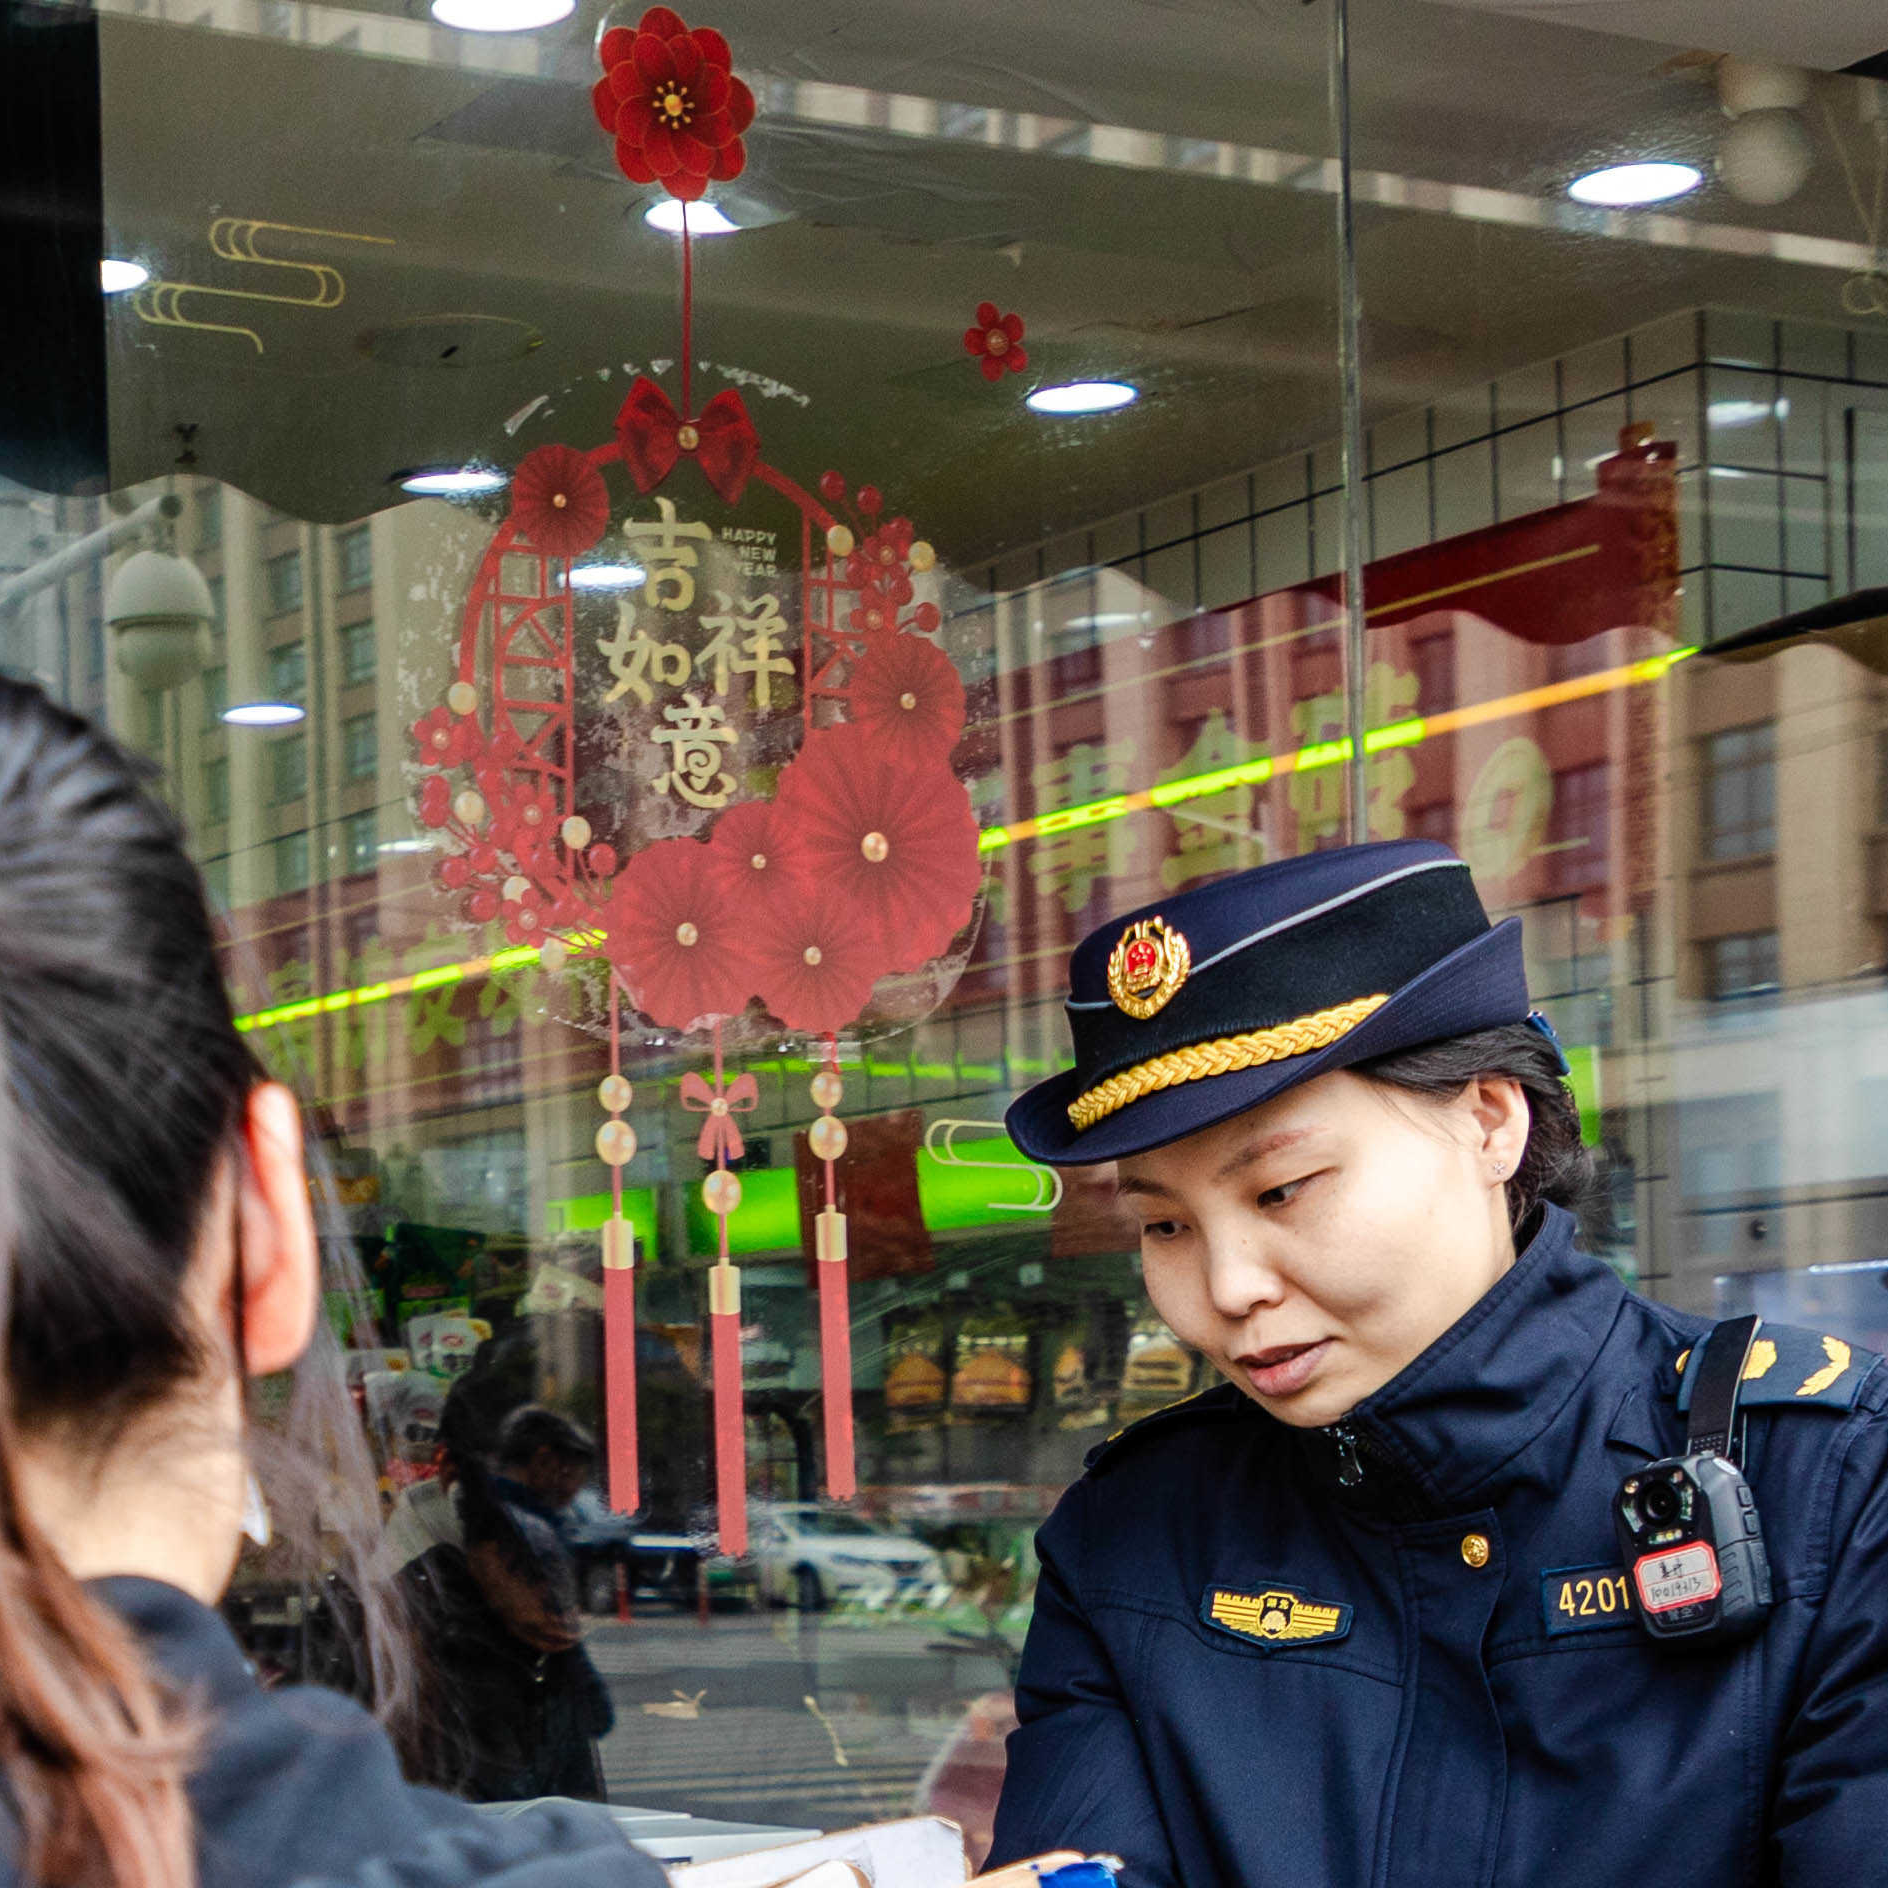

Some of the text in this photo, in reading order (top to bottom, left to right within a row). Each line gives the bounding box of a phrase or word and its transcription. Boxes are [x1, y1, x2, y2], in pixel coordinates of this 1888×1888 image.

[721, 527, 777, 546] HAPPY
[738, 546, 777, 562] NEW
[733, 562, 777, 578] YEAR
[595, 495, 797, 809] 吉祥如意
[1558, 1575, 1630, 1617] 4201
